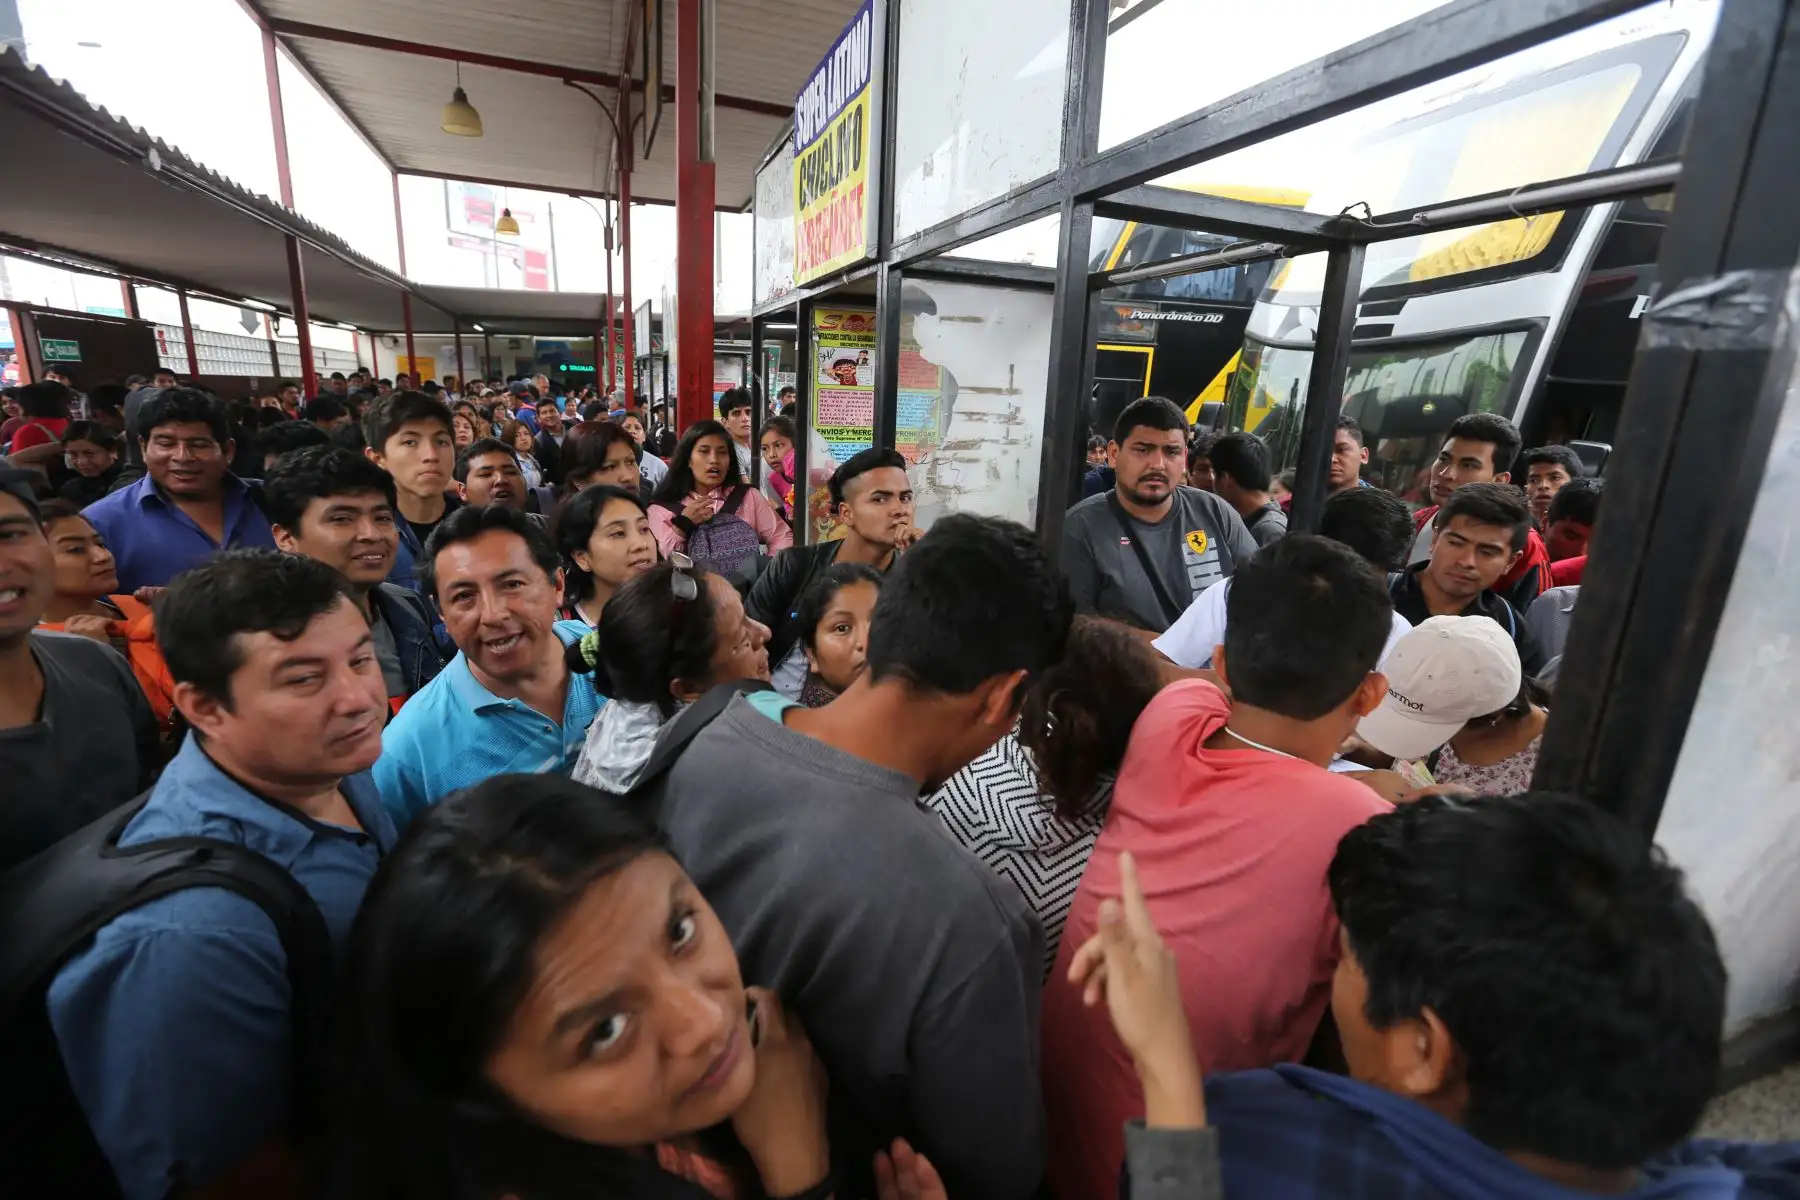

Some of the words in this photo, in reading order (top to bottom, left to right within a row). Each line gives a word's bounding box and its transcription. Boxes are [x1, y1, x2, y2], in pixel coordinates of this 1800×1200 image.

[797, 66, 827, 150] SUPER
[828, 9, 870, 120] LATINO
[799, 103, 863, 212] CHICLAYO
[1203, 313, 1223, 323] DD
[1388, 687, 1426, 713] armot
